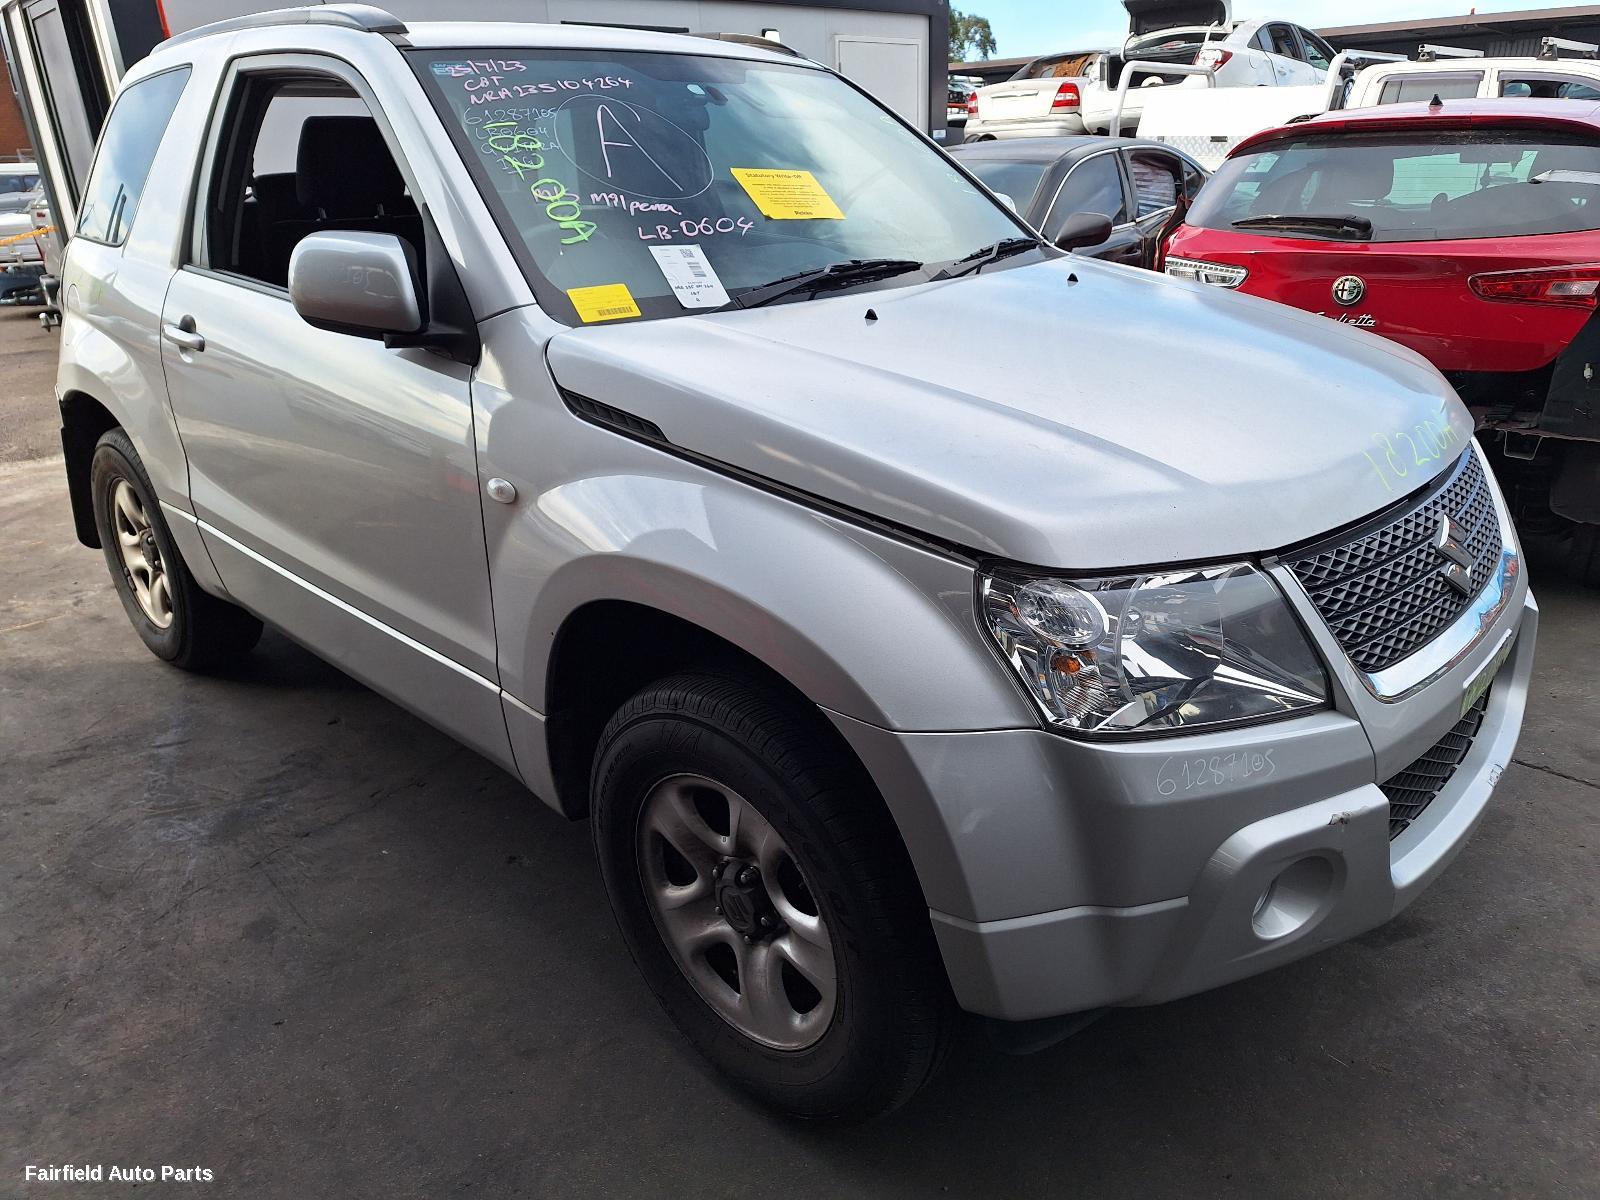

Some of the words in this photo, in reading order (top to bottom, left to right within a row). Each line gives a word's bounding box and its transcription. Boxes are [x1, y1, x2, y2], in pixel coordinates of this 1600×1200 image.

[596, 104, 684, 191] A
[637, 216, 754, 241] LB-0604
[1156, 749, 1276, 795] 61287105
